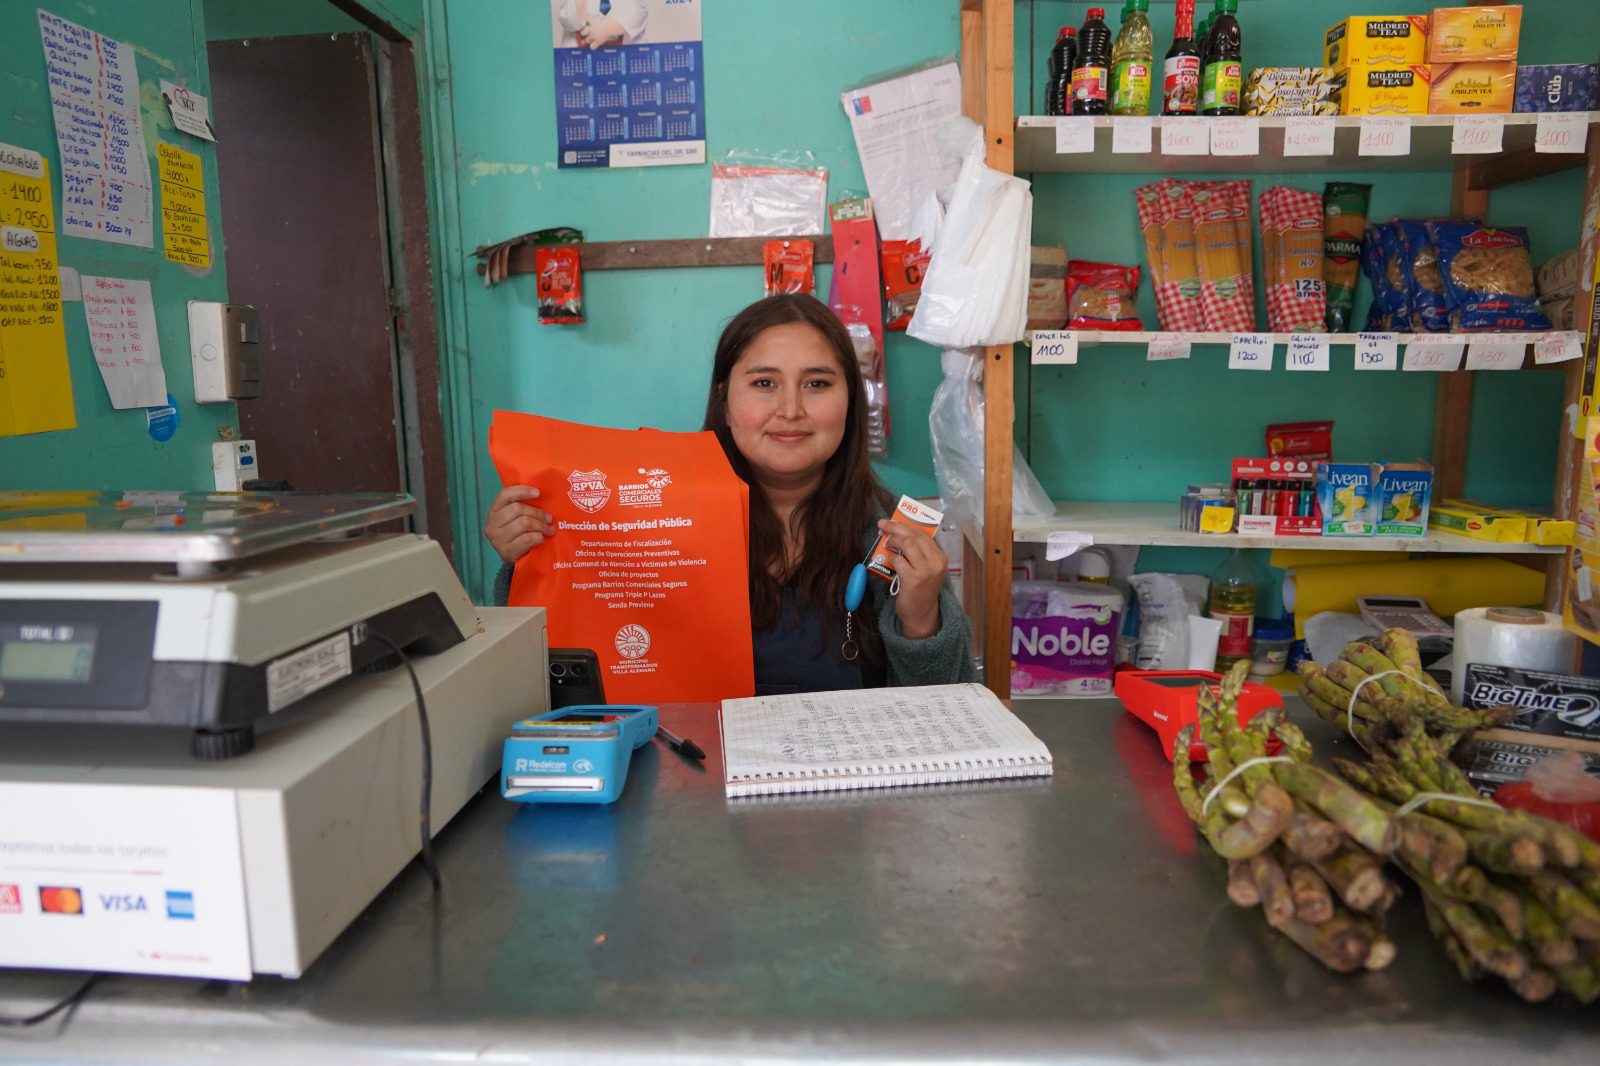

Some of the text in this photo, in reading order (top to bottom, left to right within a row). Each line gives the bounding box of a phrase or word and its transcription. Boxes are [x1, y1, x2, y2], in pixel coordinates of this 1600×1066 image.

[1175, 75, 1199, 84] SOYA
[1267, 72, 1307, 82] Deliciosa
[770, 262, 784, 285] M
[904, 264, 920, 286] C
[1294, 279, 1321, 292] 125
[1036, 343, 1065, 357] 1100
[1237, 352, 1258, 361] 1200
[1292, 352, 1315, 365] 1100
[1360, 352, 1384, 364] 1300
[573, 481, 605, 491] SPVA
[618, 483, 649, 491] BARRIOS
[1383, 478, 1429, 493] Livean
[618, 489, 663, 497] COMERCIALES
[619, 494, 662, 504] SEGUROS
[901, 501, 919, 515] PRO
[558, 516, 693, 533] Dirección de Seguridad Pública
[580, 540, 623, 549] Departamento
[632, 538, 672, 547] Fiscalización
[606, 551, 643, 559] Operaciones
[643, 548, 680, 557] Preventivas
[553, 562, 573, 570] Oficina
[573, 560, 600, 568] Comunal
[600, 560, 609, 568] de
[609, 560, 635, 568] Atención
[668, 559, 677, 567] de
[677, 556, 707, 566] Violencia
[598, 570, 660, 579] Oficina de proyectos
[572, 582, 602, 590] Programa
[662, 580, 688, 590] Seguros
[594, 592, 625, 600] Programa
[625, 591, 642, 599] Triple
[608, 601, 655, 609] Senda Previene
[1011, 625, 1110, 656] Noble
[1080, 679, 1088, 687] 4
[98, 894, 149, 912] VISA
